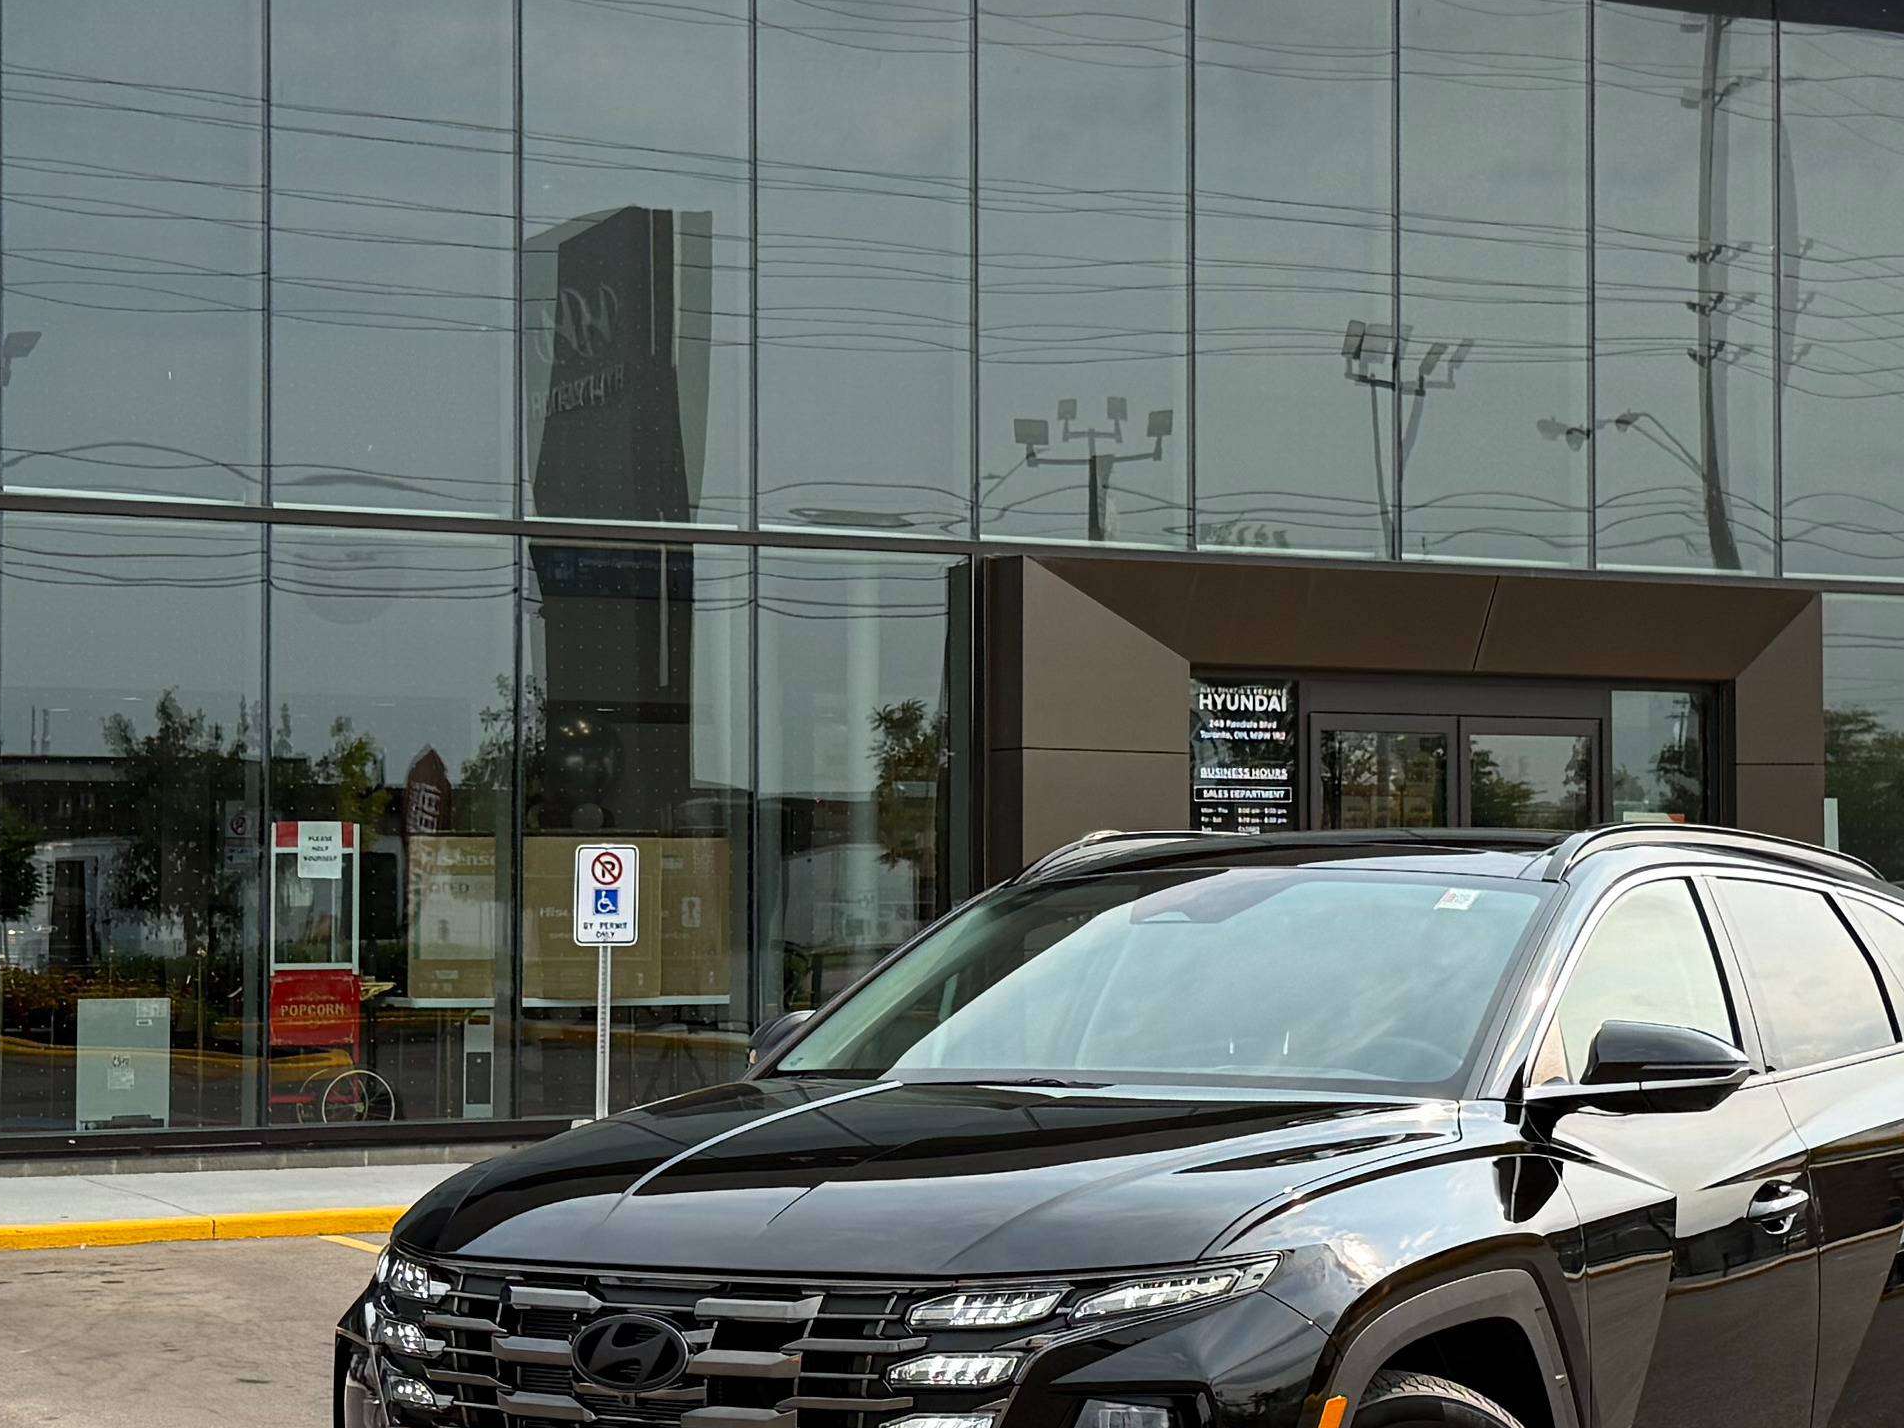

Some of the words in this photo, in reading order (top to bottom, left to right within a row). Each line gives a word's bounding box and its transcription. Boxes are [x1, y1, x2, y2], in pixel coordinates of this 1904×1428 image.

[1199, 693, 1287, 712] HYUNDAI
[1200, 767, 1250, 779] BUSINESS
[1252, 767, 1288, 780] HOURS
[583, 922, 594, 930] BY
[599, 922, 628, 930] PERMIT
[596, 931, 615, 939] ONLY
[280, 1003, 345, 1017] POPCORN
